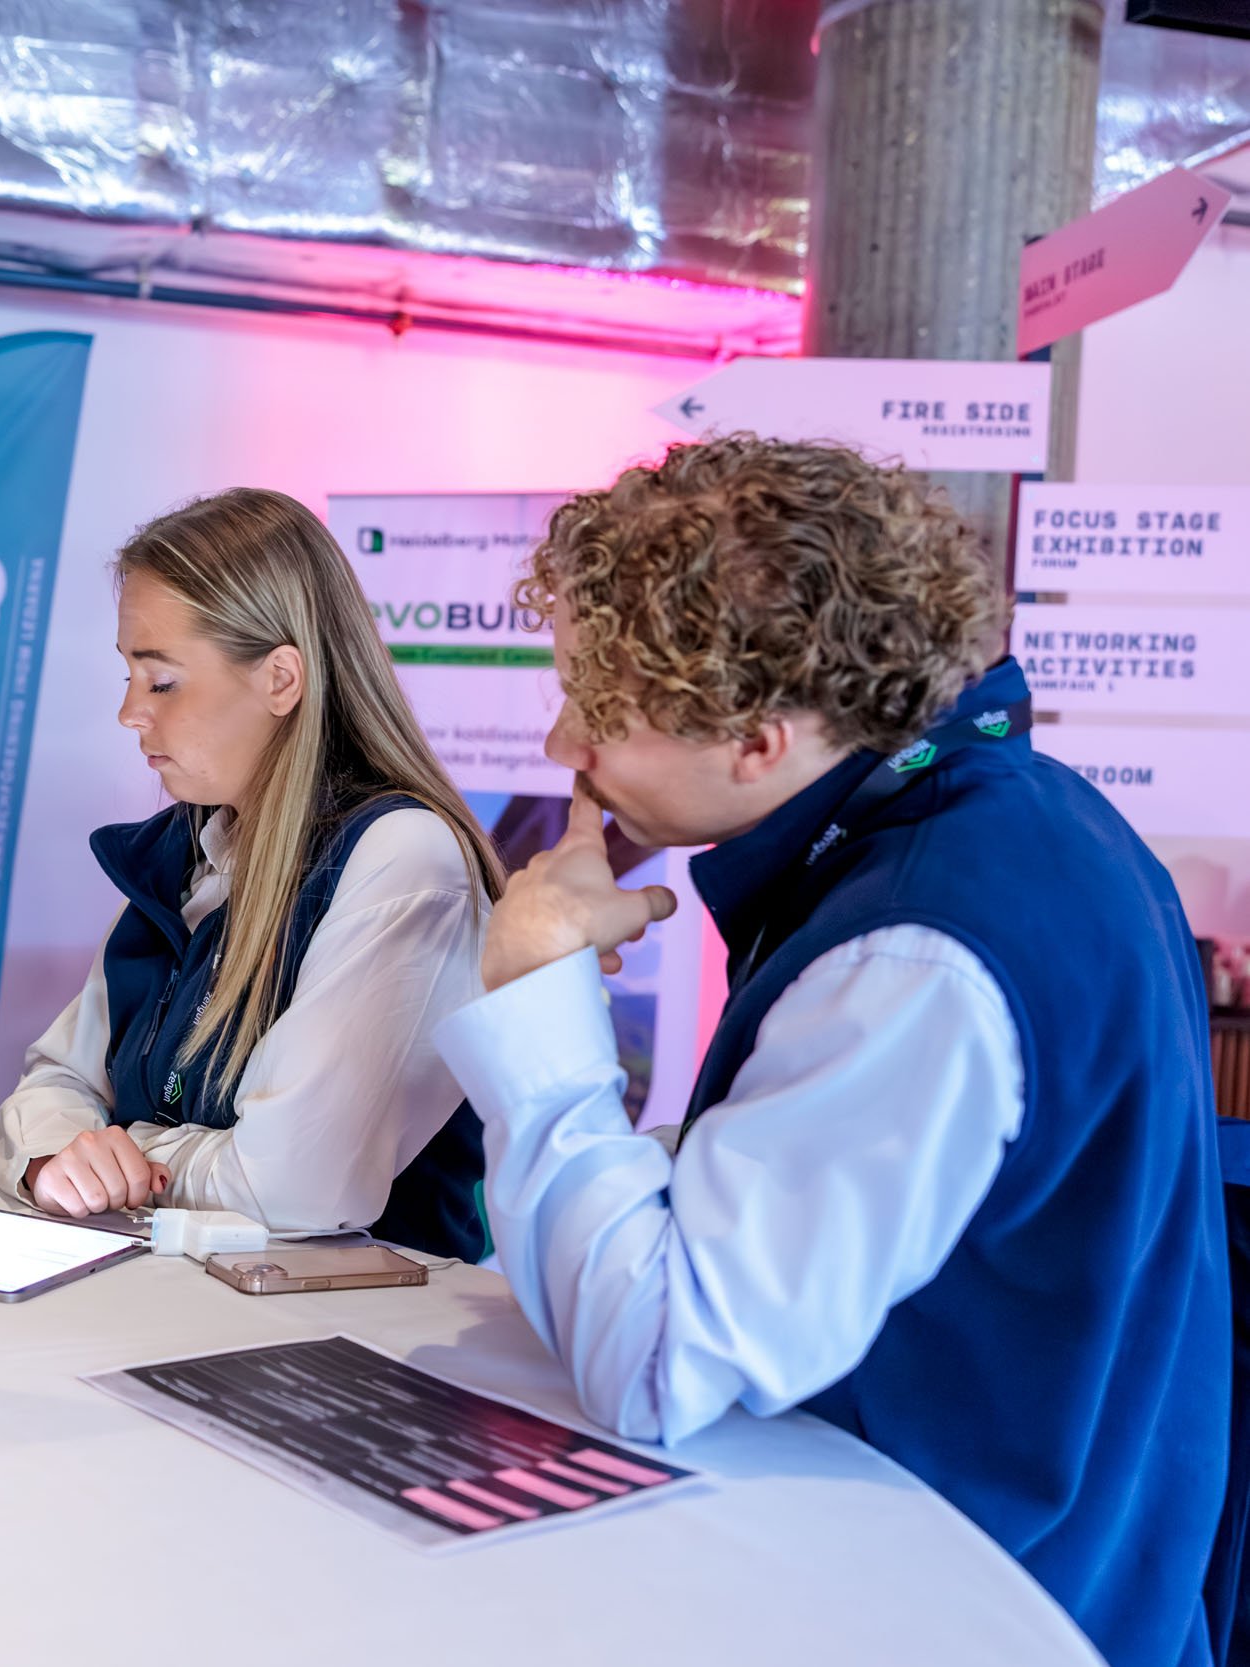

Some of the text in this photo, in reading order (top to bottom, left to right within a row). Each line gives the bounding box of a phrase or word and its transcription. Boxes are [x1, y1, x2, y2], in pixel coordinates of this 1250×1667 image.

[882, 400, 1030, 422] FIRE SIDE
[1034, 509, 1220, 531] FOCUS STAGE
[1032, 534, 1204, 557] EXHIBITION
[1031, 558, 1078, 569] FORUM
[1024, 631, 1197, 652] NETWORKING
[1024, 656, 1196, 678] ACTIVITIES
[193, 991, 213, 1025] zengun
[162, 1070, 178, 1103] zengun
